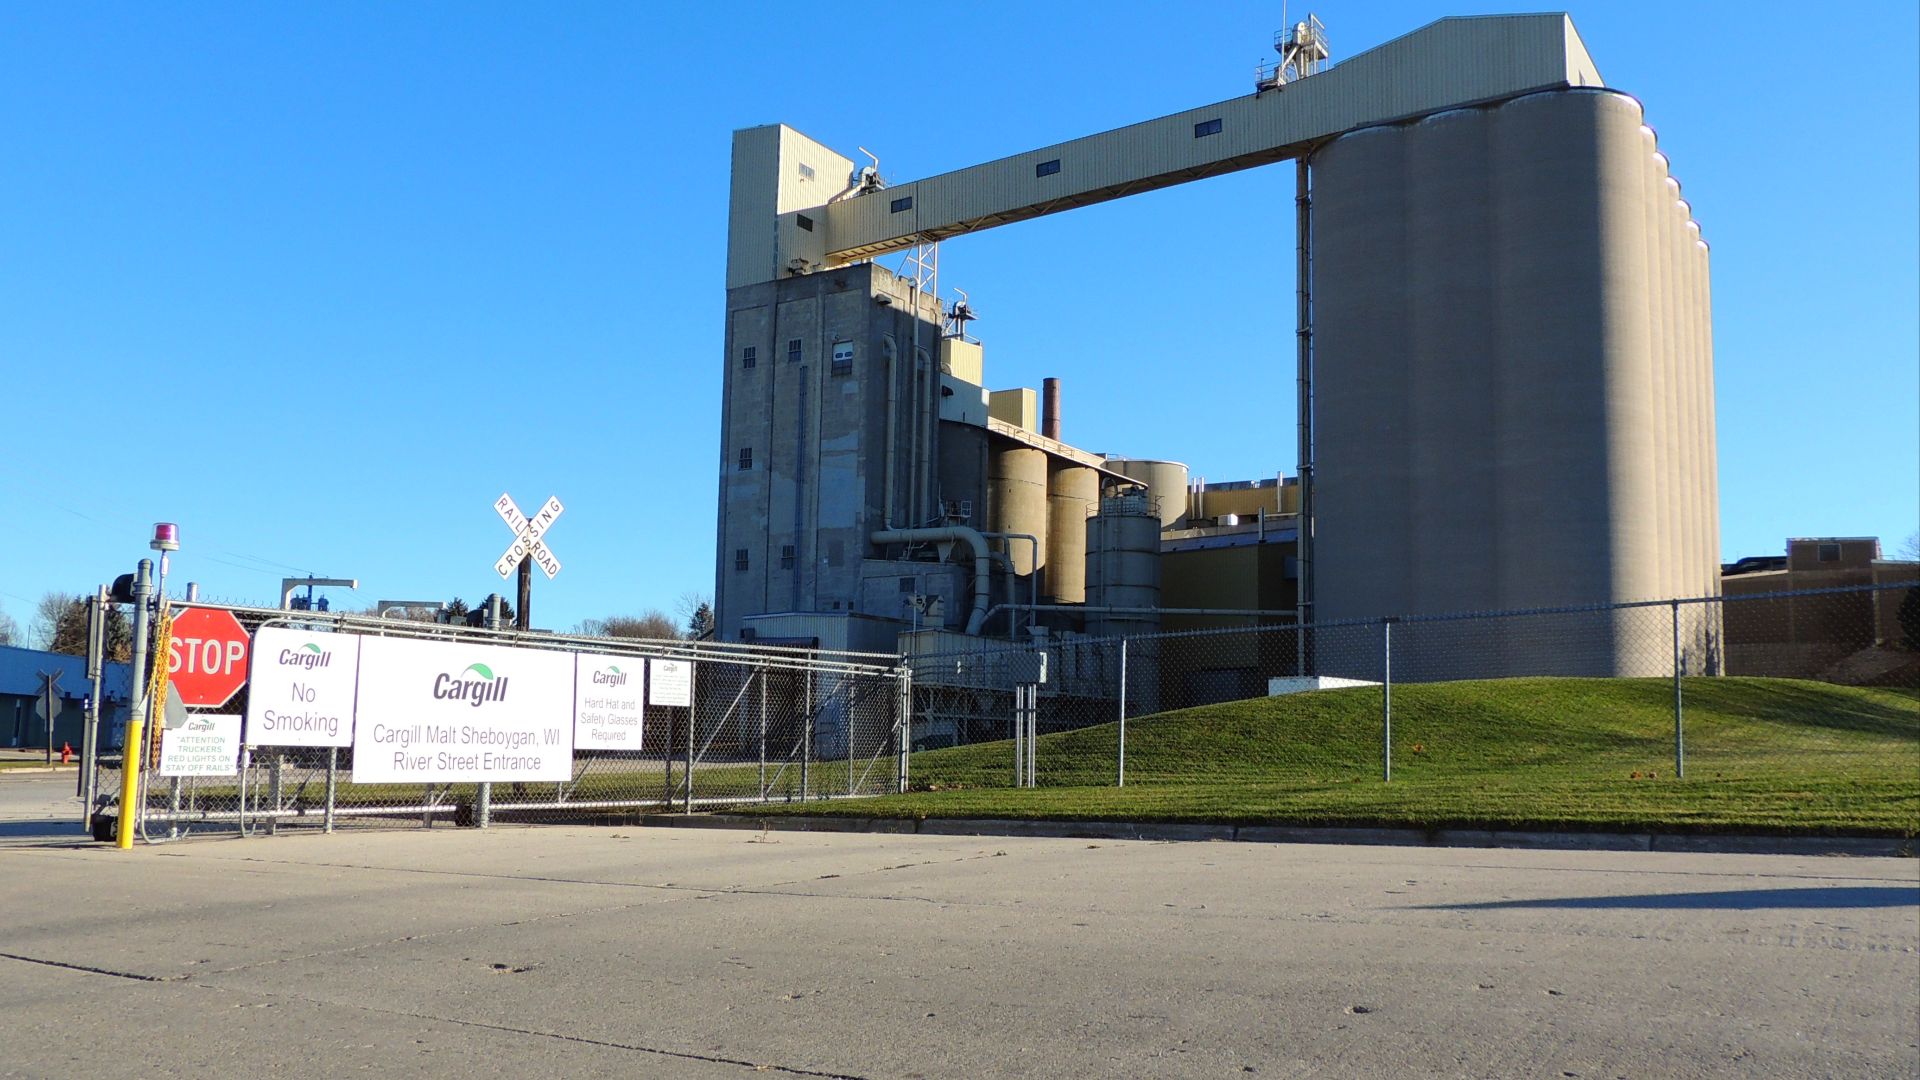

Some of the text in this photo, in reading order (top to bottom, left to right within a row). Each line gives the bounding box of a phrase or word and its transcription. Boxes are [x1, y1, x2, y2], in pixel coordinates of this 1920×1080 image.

[498, 500, 560, 576] CROSSING
[169, 636, 245, 675] STOP
[279, 648, 332, 670] Cargill
[592, 670, 627, 688] Cargill
[291, 682, 316, 703] No
[433, 672, 509, 707] Cargill
[584, 697, 636, 710] Hard Hat and
[188, 722, 216, 732] Cargill
[263, 709, 339, 737] Smoking
[580, 712, 638, 727] Safety Glasses
[373, 723, 560, 750] Cargill Malt Sheboygan, WI
[591, 728, 627, 742] Required
[178, 745, 222, 753] TRUCKERS
[165, 764, 187, 772] STAY
[187, 764, 204, 772] OFF
[187, 755, 216, 763] LIGHTS
[393, 751, 541, 770] River Street Entrance
